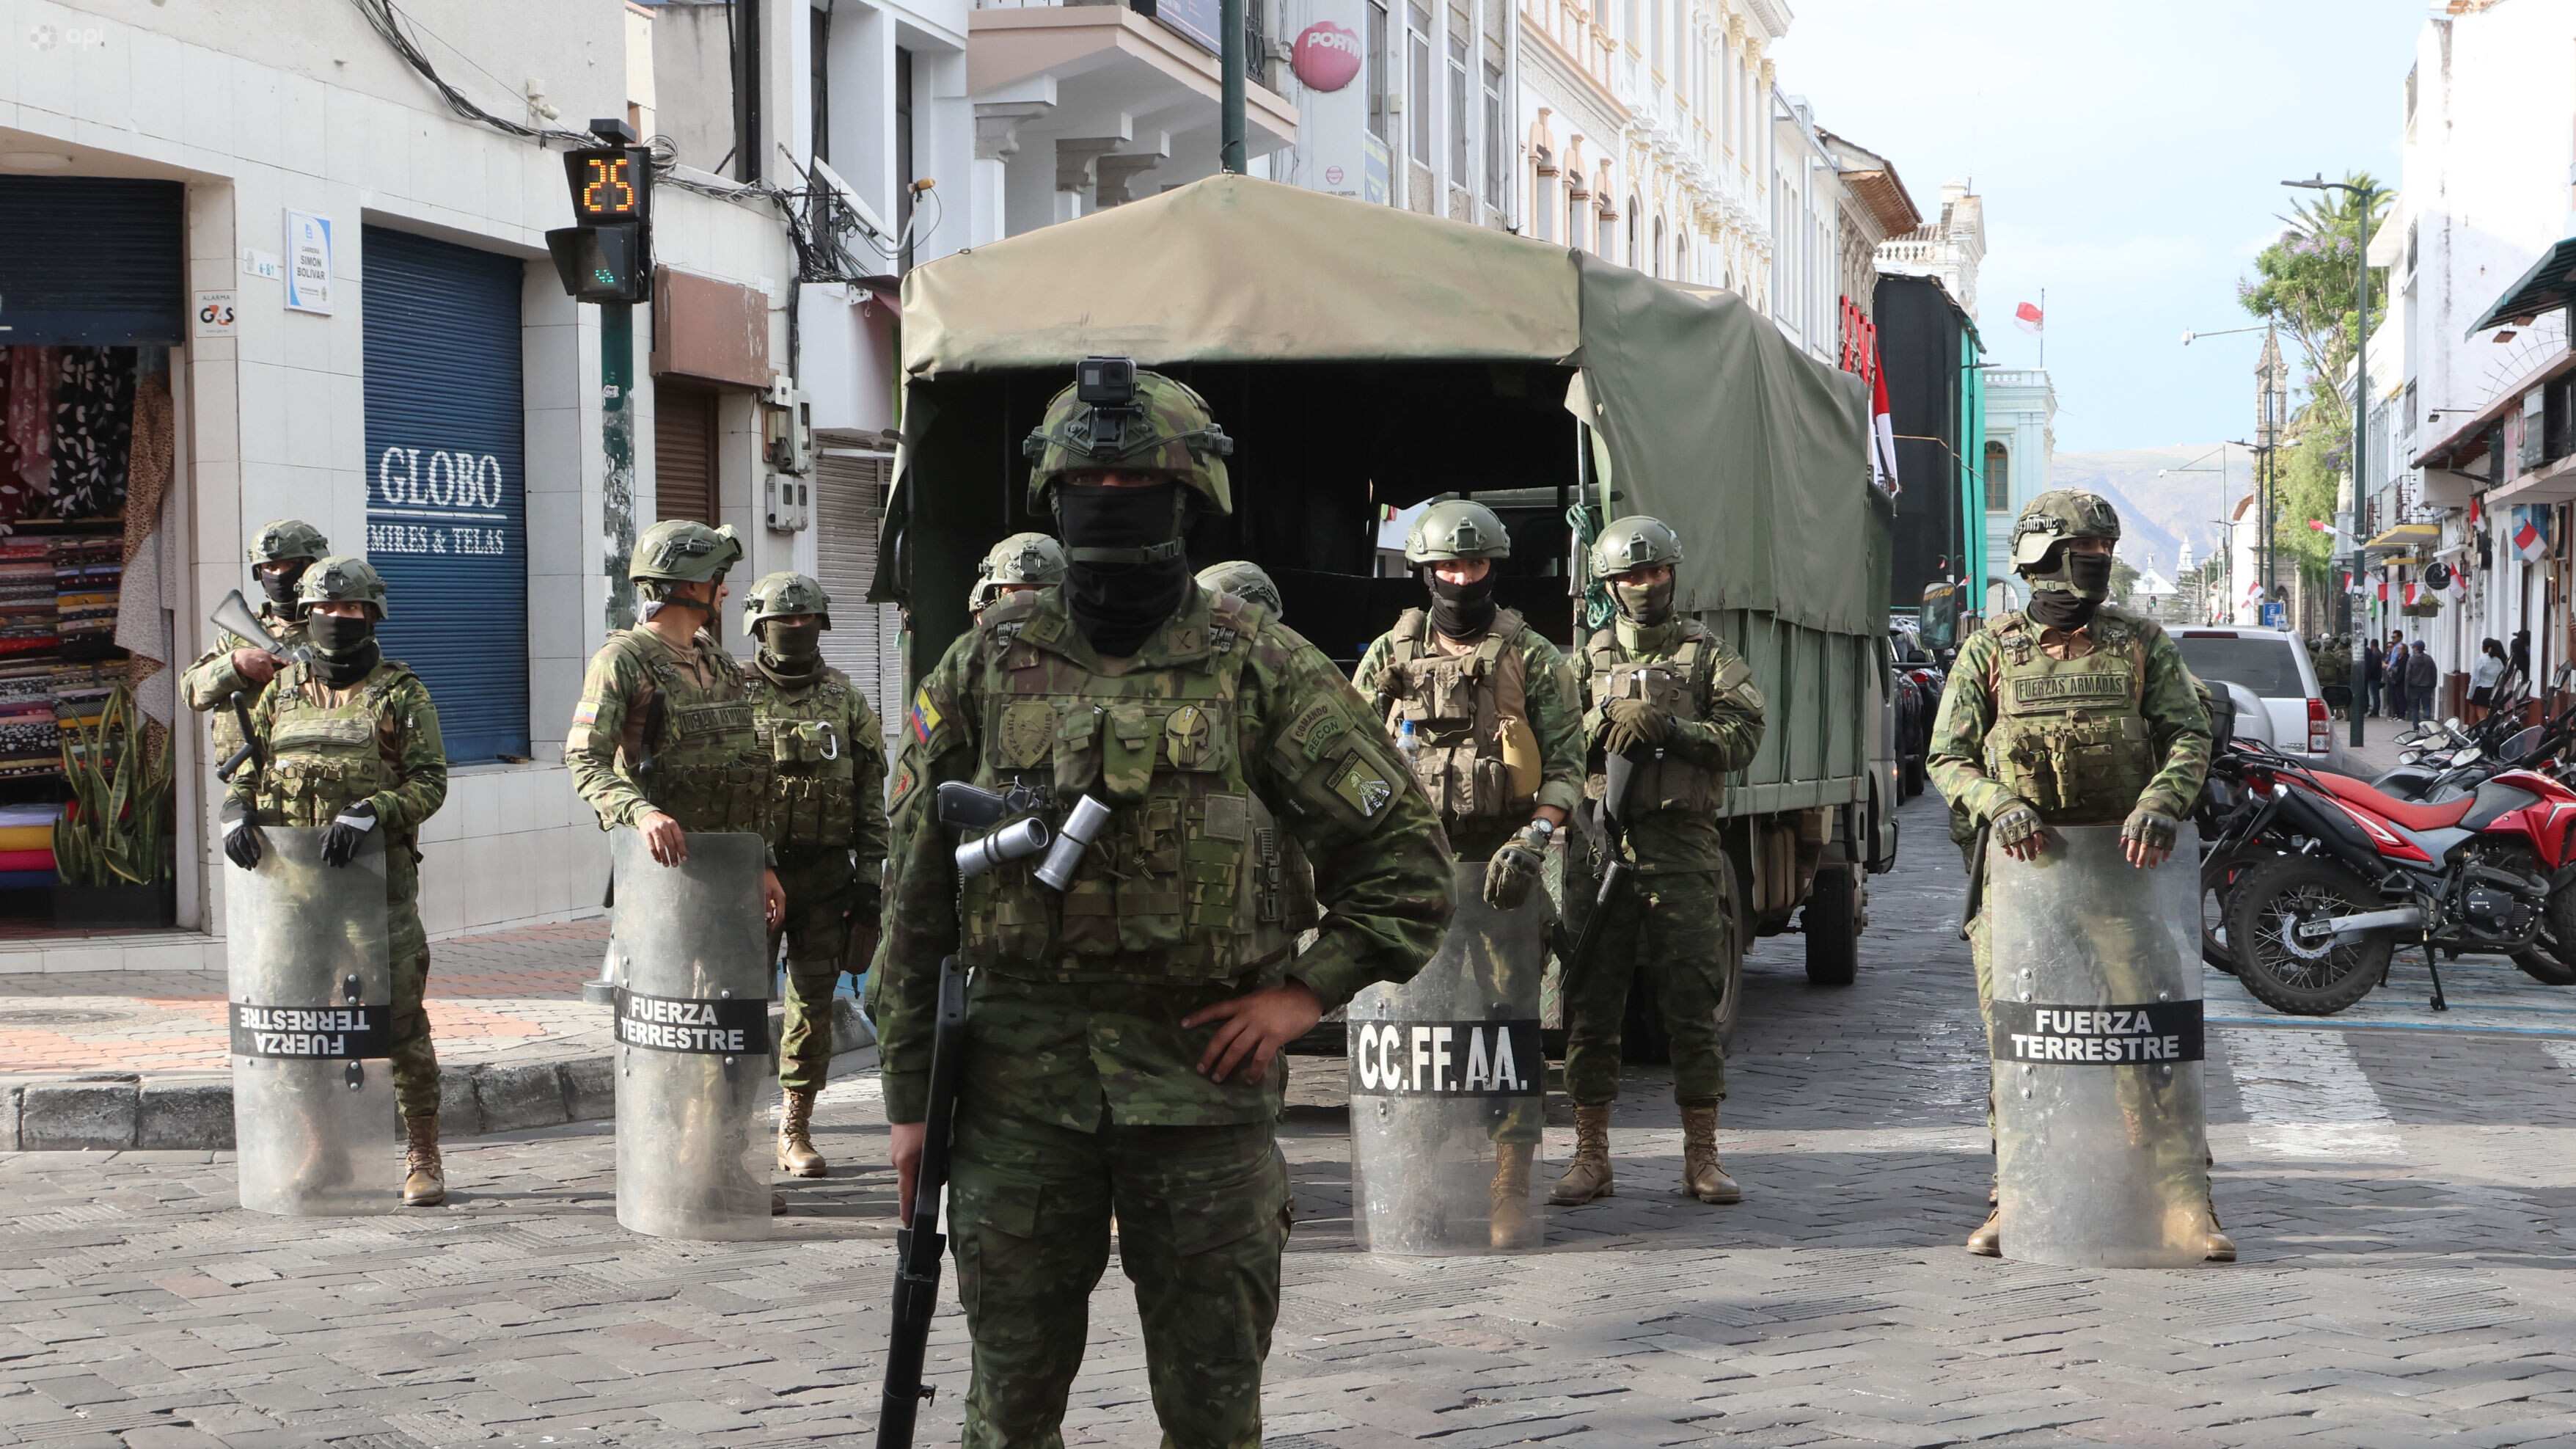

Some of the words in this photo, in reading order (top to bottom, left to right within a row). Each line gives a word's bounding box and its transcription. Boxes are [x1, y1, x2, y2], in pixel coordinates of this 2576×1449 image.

[584, 159, 634, 211] 25
[380, 447, 502, 508] GLOBO
[367, 524, 428, 553] MIRES
[433, 528, 446, 553] &
[452, 528, 505, 555] TELAS
[2019, 679, 2065, 699] FUERZAS
[2071, 676, 2123, 694] ARMADAS
[1295, 705, 1328, 737] COMANDO
[1308, 721, 1339, 753] RECON
[240, 1007, 370, 1031] TERRESTRE
[631, 996, 718, 1026] FUERZA
[2036, 1010, 2153, 1034] FUERZA
[254, 1032, 344, 1054] FUERZA
[621, 1017, 744, 1051] TERRESTRE
[2011, 1034, 2180, 1061] TERRESTRE
